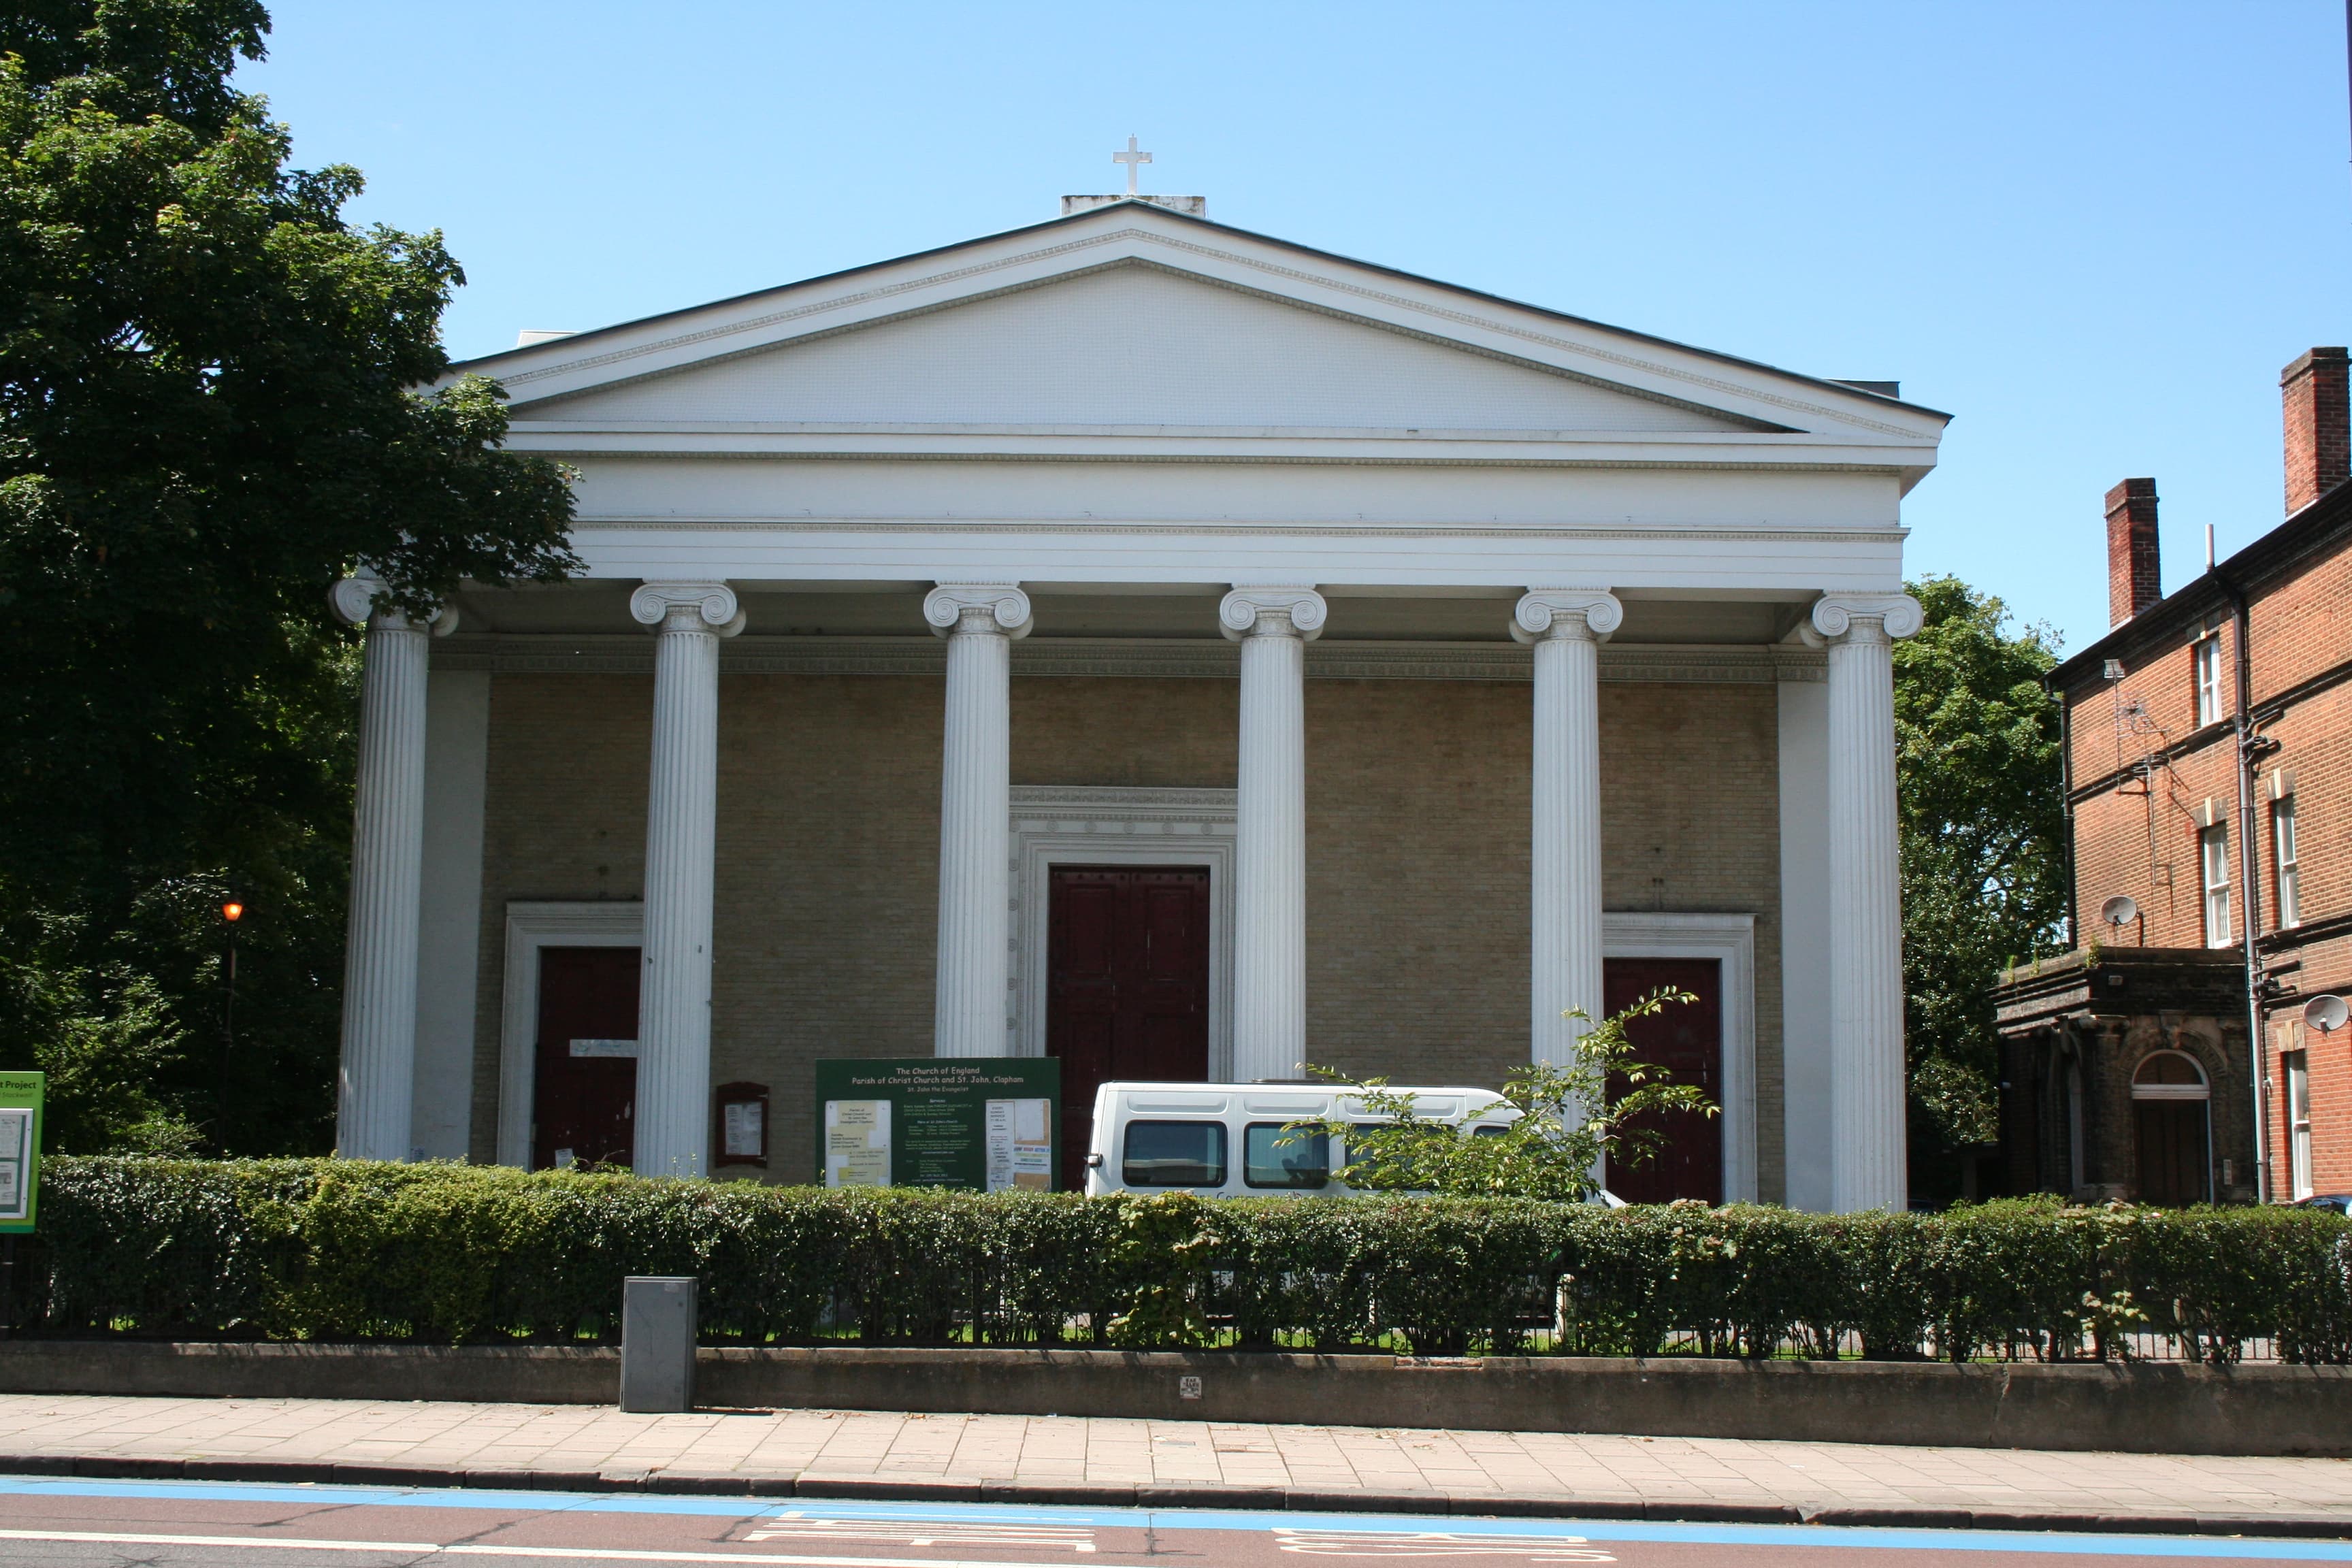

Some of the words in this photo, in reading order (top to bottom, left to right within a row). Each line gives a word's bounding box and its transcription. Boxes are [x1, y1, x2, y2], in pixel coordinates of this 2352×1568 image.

[941, 1066, 949, 1075] of
[951, 1066, 980, 1076] England
[5, 1080, 37, 1090] Project
[993, 1076, 1024, 1084] Clapham
[740, 1510, 1096, 1553] LANE
[1271, 1526, 1618, 1563] BUS
